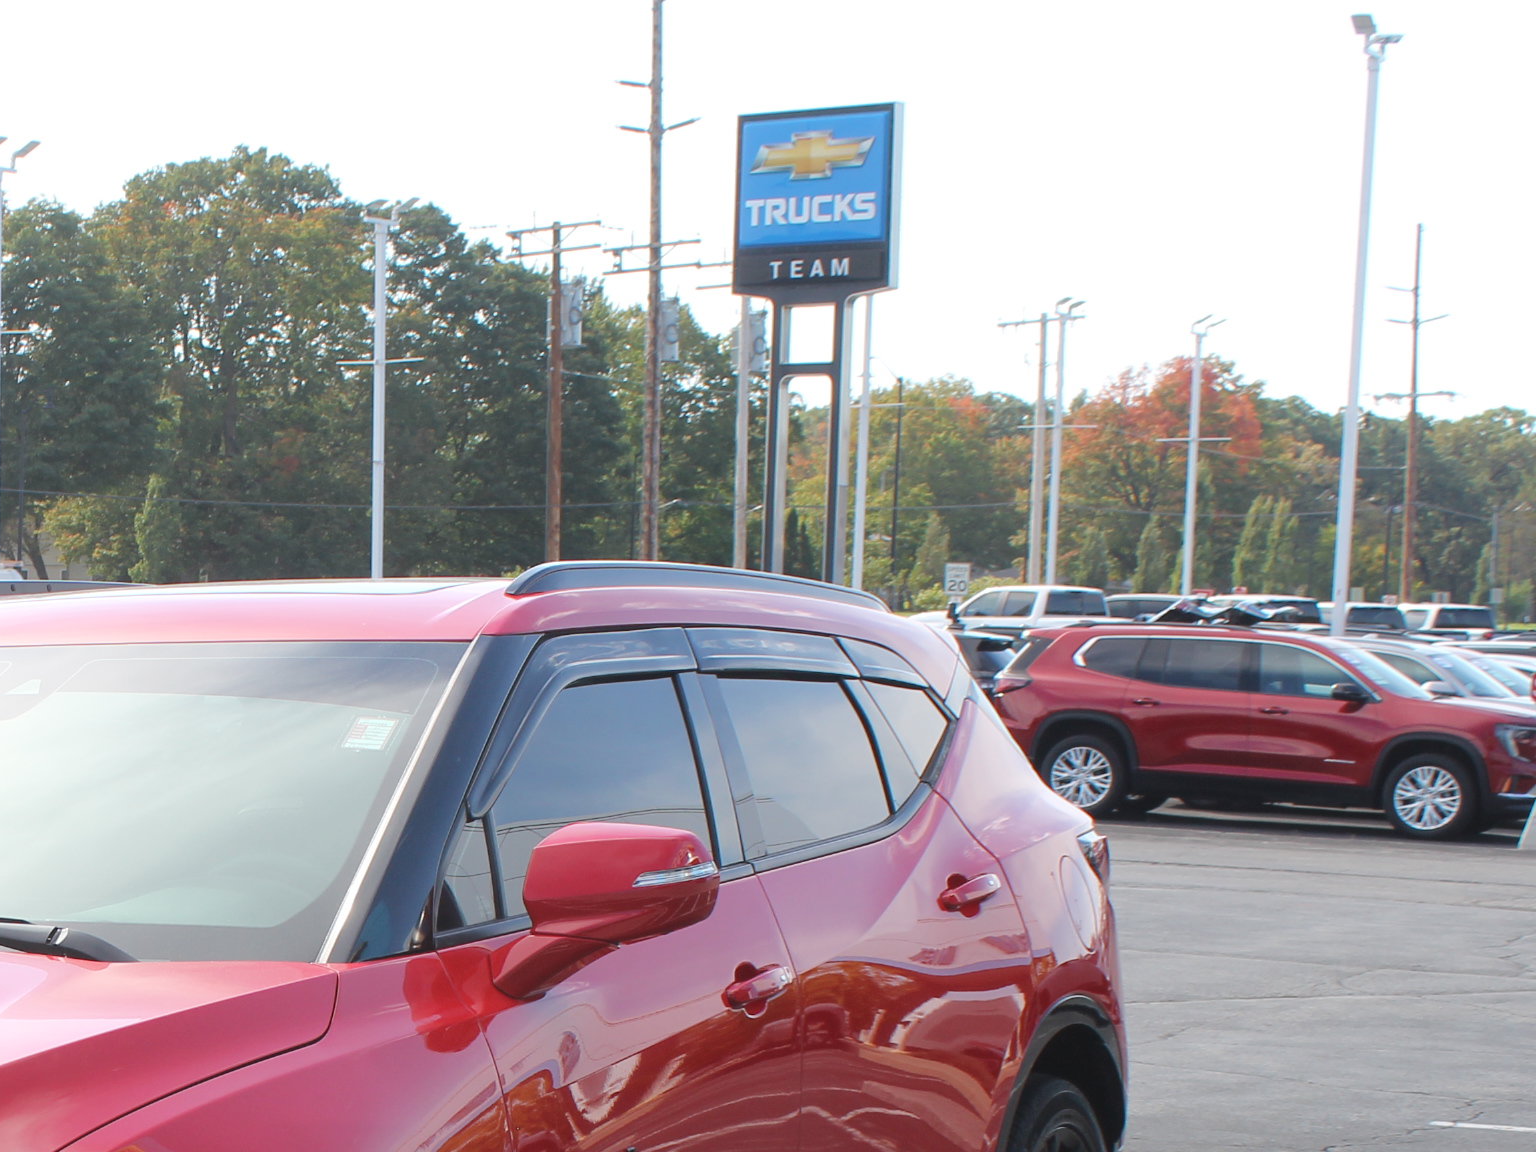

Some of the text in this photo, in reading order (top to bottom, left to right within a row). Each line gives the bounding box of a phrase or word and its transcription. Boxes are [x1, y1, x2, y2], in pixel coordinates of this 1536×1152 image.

[745, 192, 877, 227] TRUCKS
[769, 257, 850, 280] TEAM
[947, 579, 968, 592] 20
